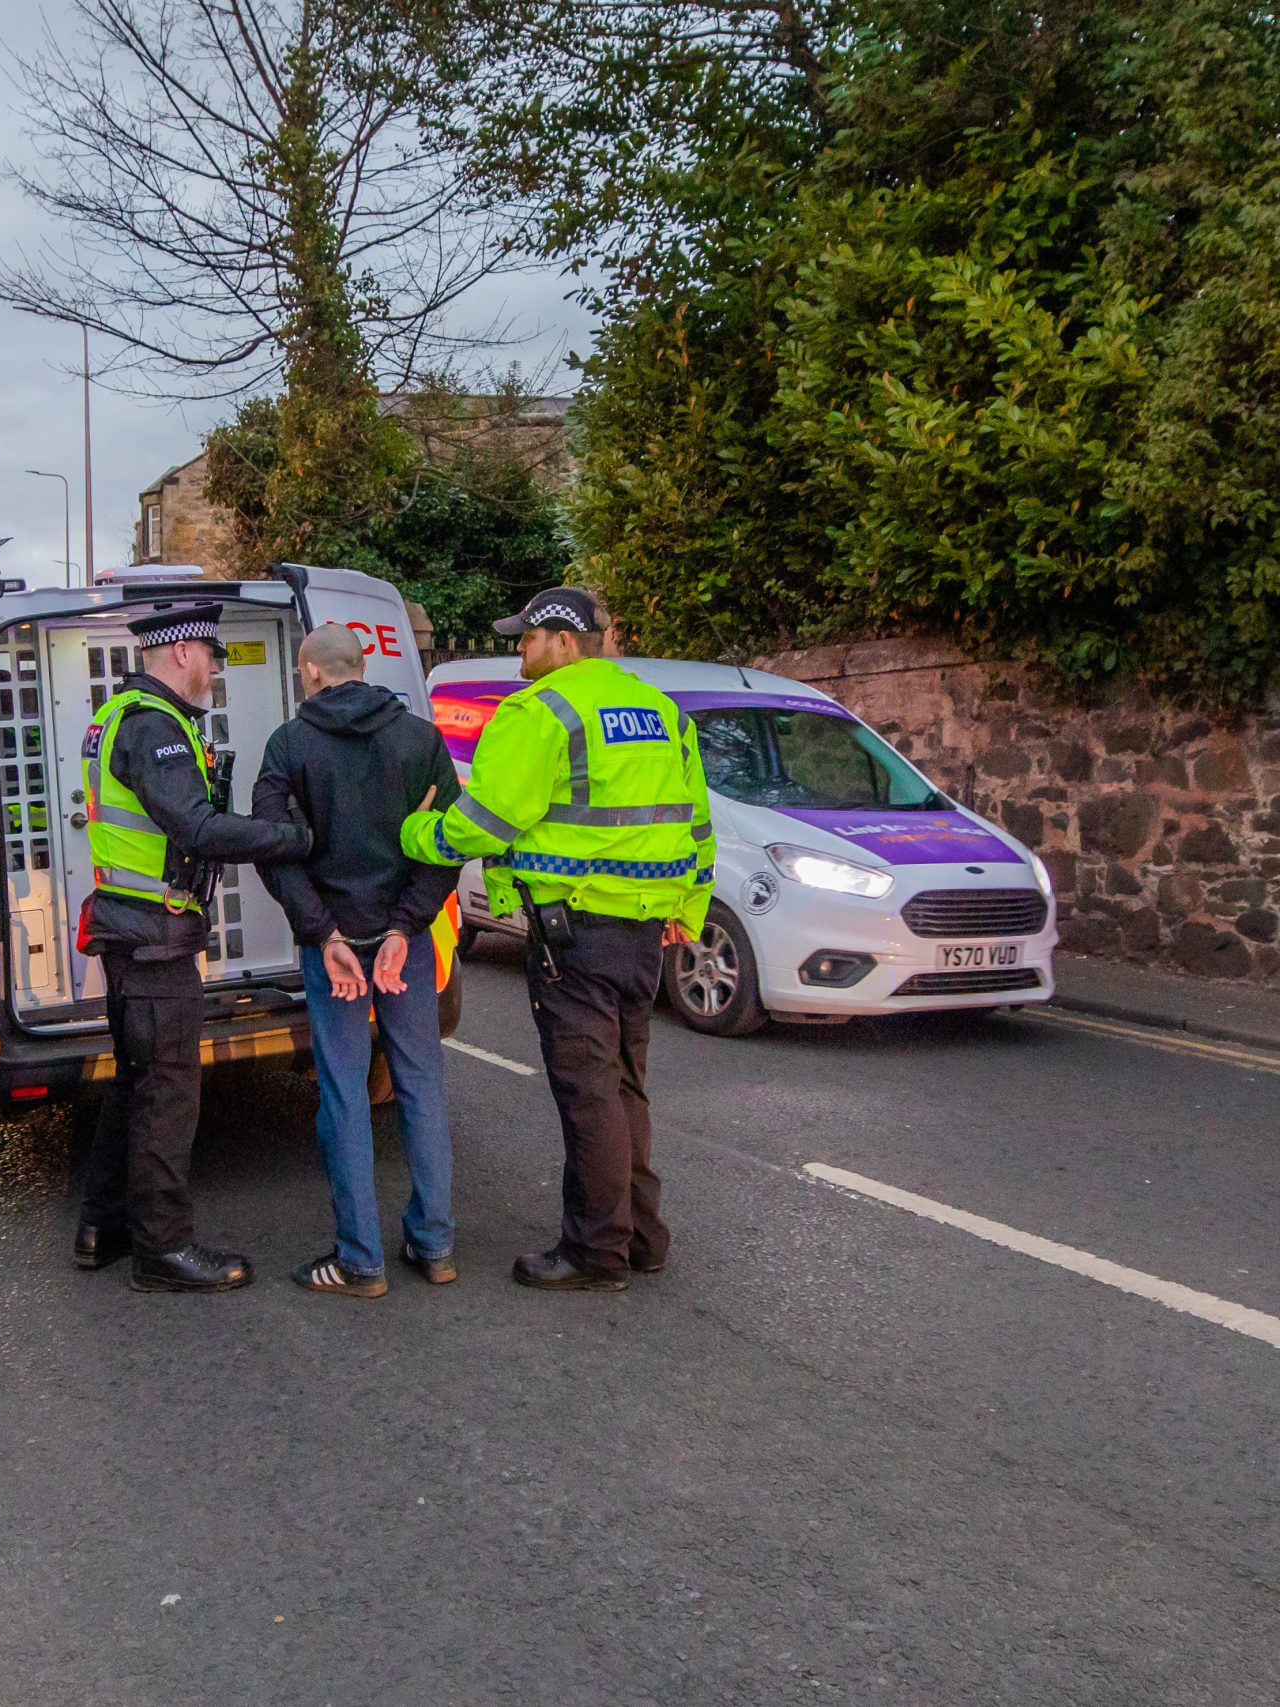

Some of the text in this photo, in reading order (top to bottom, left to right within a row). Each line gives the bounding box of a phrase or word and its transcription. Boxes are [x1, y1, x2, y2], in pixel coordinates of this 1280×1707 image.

[326, 621, 402, 657] CE
[156, 743, 189, 758] POLICE
[943, 947, 984, 967] YS70
